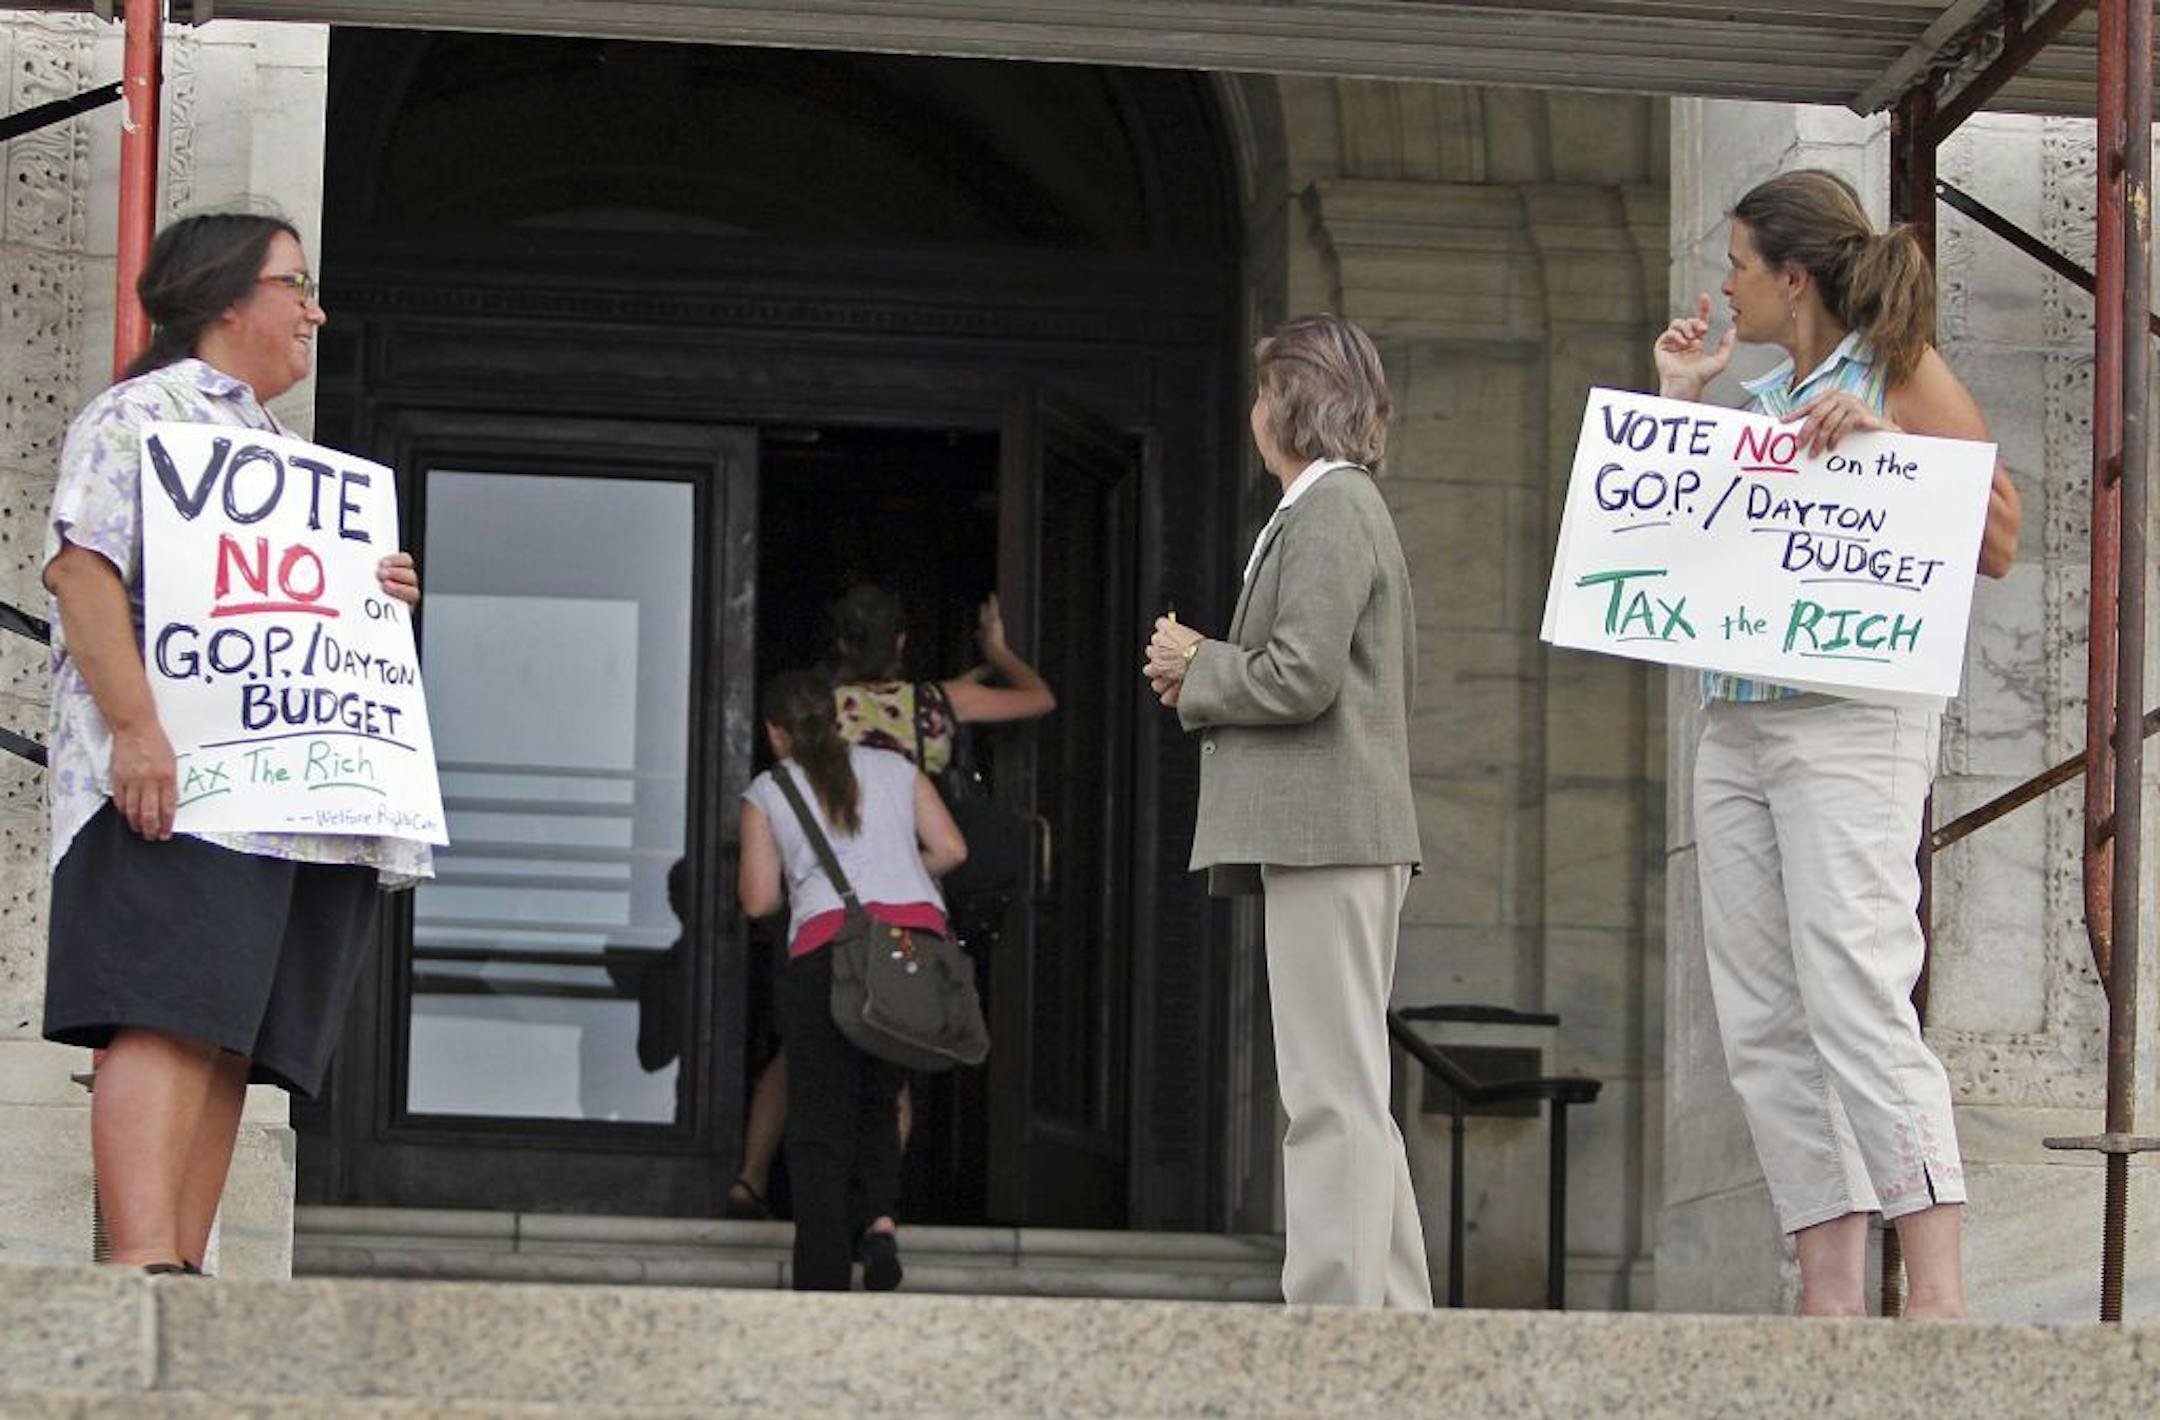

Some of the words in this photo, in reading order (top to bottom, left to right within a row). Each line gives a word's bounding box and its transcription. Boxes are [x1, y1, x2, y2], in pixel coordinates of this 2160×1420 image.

[1602, 404, 1717, 456] VOTE
[1733, 426, 1801, 464] NO
[1826, 452, 1863, 475] on
[1874, 451, 1919, 480] the
[146, 433, 373, 544] VOTE
[214, 532, 325, 602] NO
[364, 598, 399, 624] on
[1781, 531, 1945, 587] BUDGET
[1574, 568, 1697, 640] TAX
[1721, 604, 1768, 641] the
[1781, 598, 1923, 654] RICH
[241, 682, 402, 737] BUDGET
[173, 752, 231, 794] AX
[243, 746, 291, 784] The
[304, 740, 375, 782] Rich
